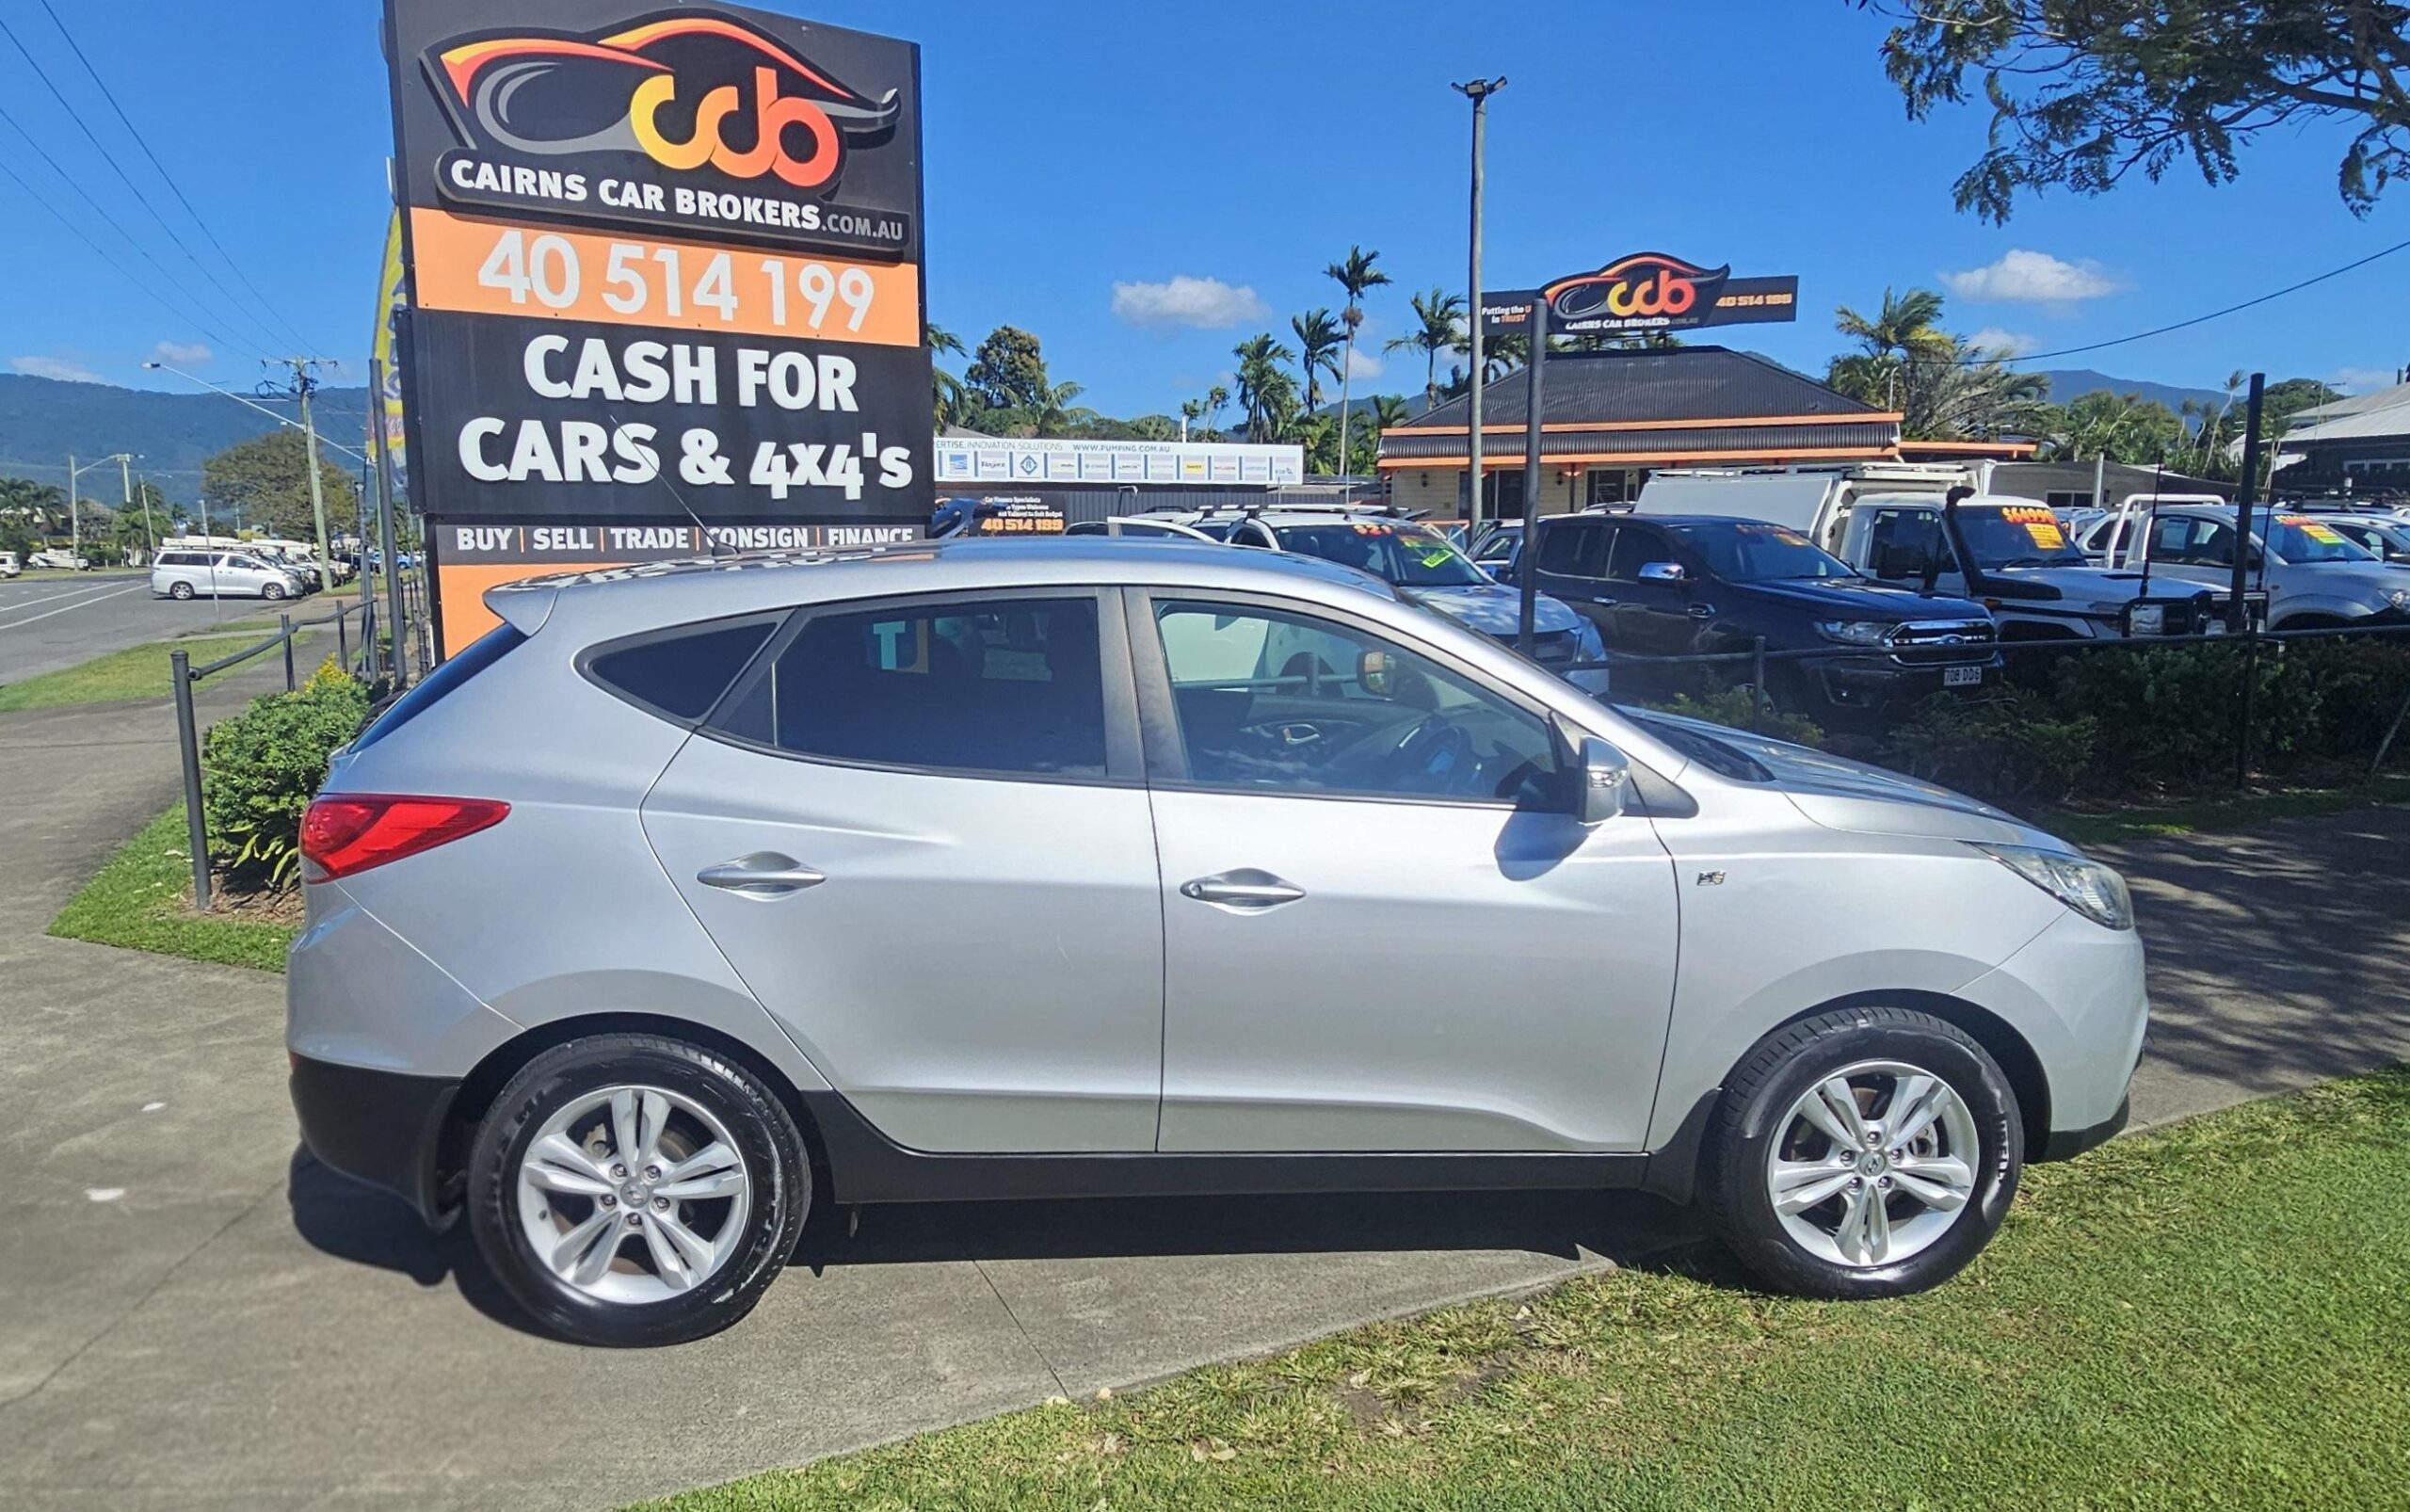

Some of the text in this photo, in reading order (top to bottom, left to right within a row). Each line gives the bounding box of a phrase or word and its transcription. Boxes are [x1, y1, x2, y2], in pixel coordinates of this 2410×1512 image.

[450, 159, 588, 201] CAIRNS
[598, 178, 667, 212] CAR
[477, 230, 876, 333] 40 514 199
[1510, 305, 1524, 314] the
[1602, 319, 1623, 329] CAR
[523, 333, 860, 412] CASH FOR
[458, 416, 660, 484] CARS
[679, 427, 736, 486] &
[457, 527, 513, 551] BUY
[533, 527, 594, 551] SELL
[610, 527, 690, 550] TRADE
[827, 527, 913, 547] FINANCE
[981, 518, 1064, 531] 40 514 199
